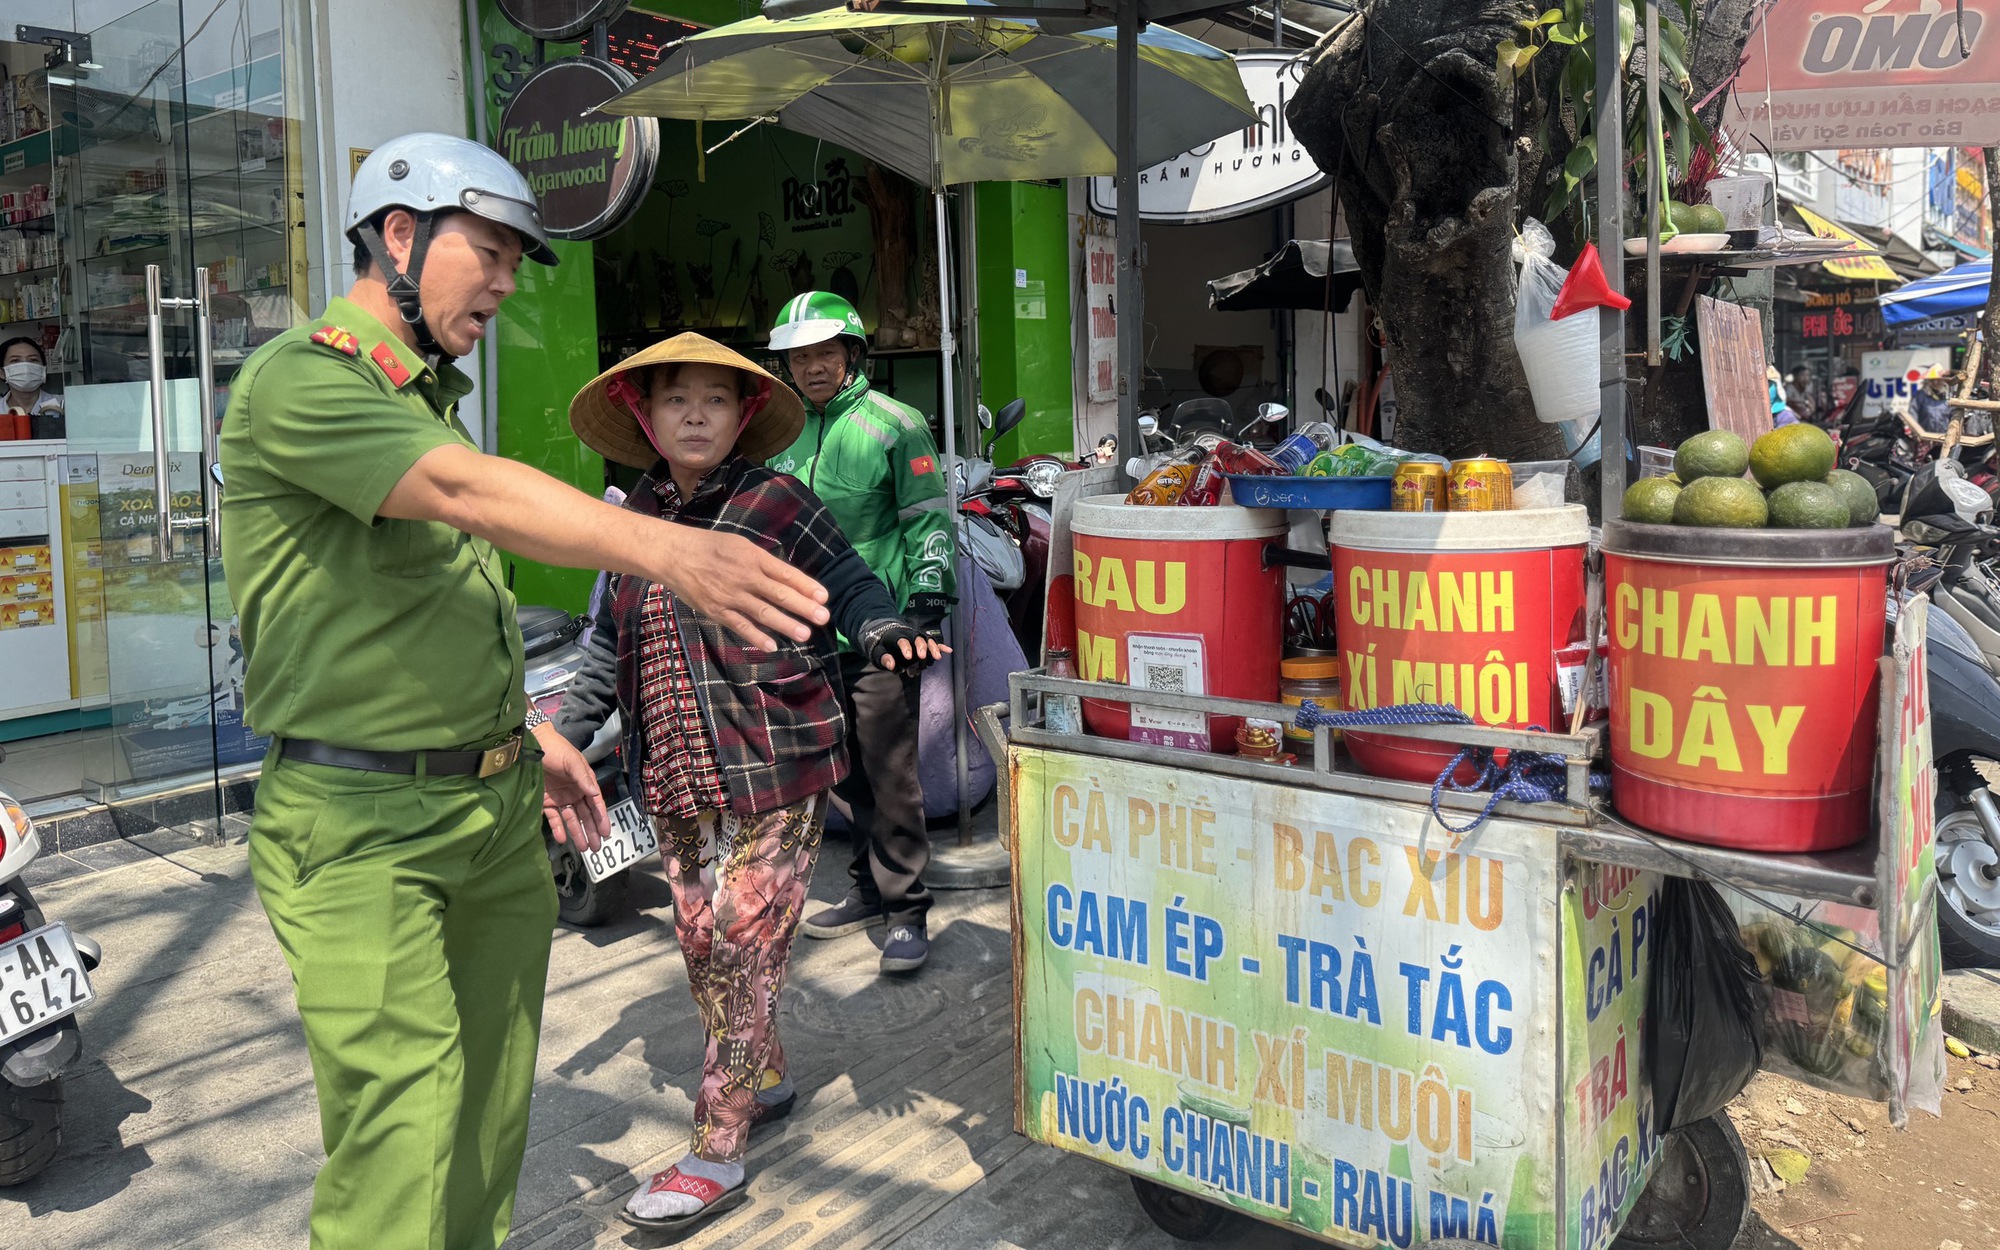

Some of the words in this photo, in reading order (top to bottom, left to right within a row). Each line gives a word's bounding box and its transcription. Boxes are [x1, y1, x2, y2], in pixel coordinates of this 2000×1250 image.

[504, 121, 558, 164] Trầm
[562, 118, 626, 160] hương
[1214, 150, 1301, 175] HƯƠNG
[527, 158, 606, 198] Agarwood
[122, 461, 181, 476] Dermix
[1073, 549, 1186, 615] RAU
[1349, 565, 1514, 633] CHANH
[1078, 627, 1128, 685] M
[1615, 582, 1837, 666] CHANH
[1630, 685, 1806, 775] DÂY
[1052, 785, 1112, 854] CÀ
[1129, 795, 1217, 876] PHÊ
[1273, 822, 1381, 915] BẠC
[0, 935, 60, 990] -AA
[1046, 883, 1149, 966] CAM
[1164, 896, 1225, 980] ÉP
[1277, 935, 1382, 1027] TRÀ
[1398, 945, 1515, 1056] TẮC
[1586, 916, 1623, 1023] CÀ
[1075, 987, 1236, 1094] CHANH
[1252, 1028, 1306, 1111] XÍ
[1325, 1052, 1475, 1169] MUỘI
[1054, 1072, 1151, 1163] NƯỚC
[1161, 1107, 1291, 1211] CHANH
[1332, 1160, 1413, 1249] RAU
